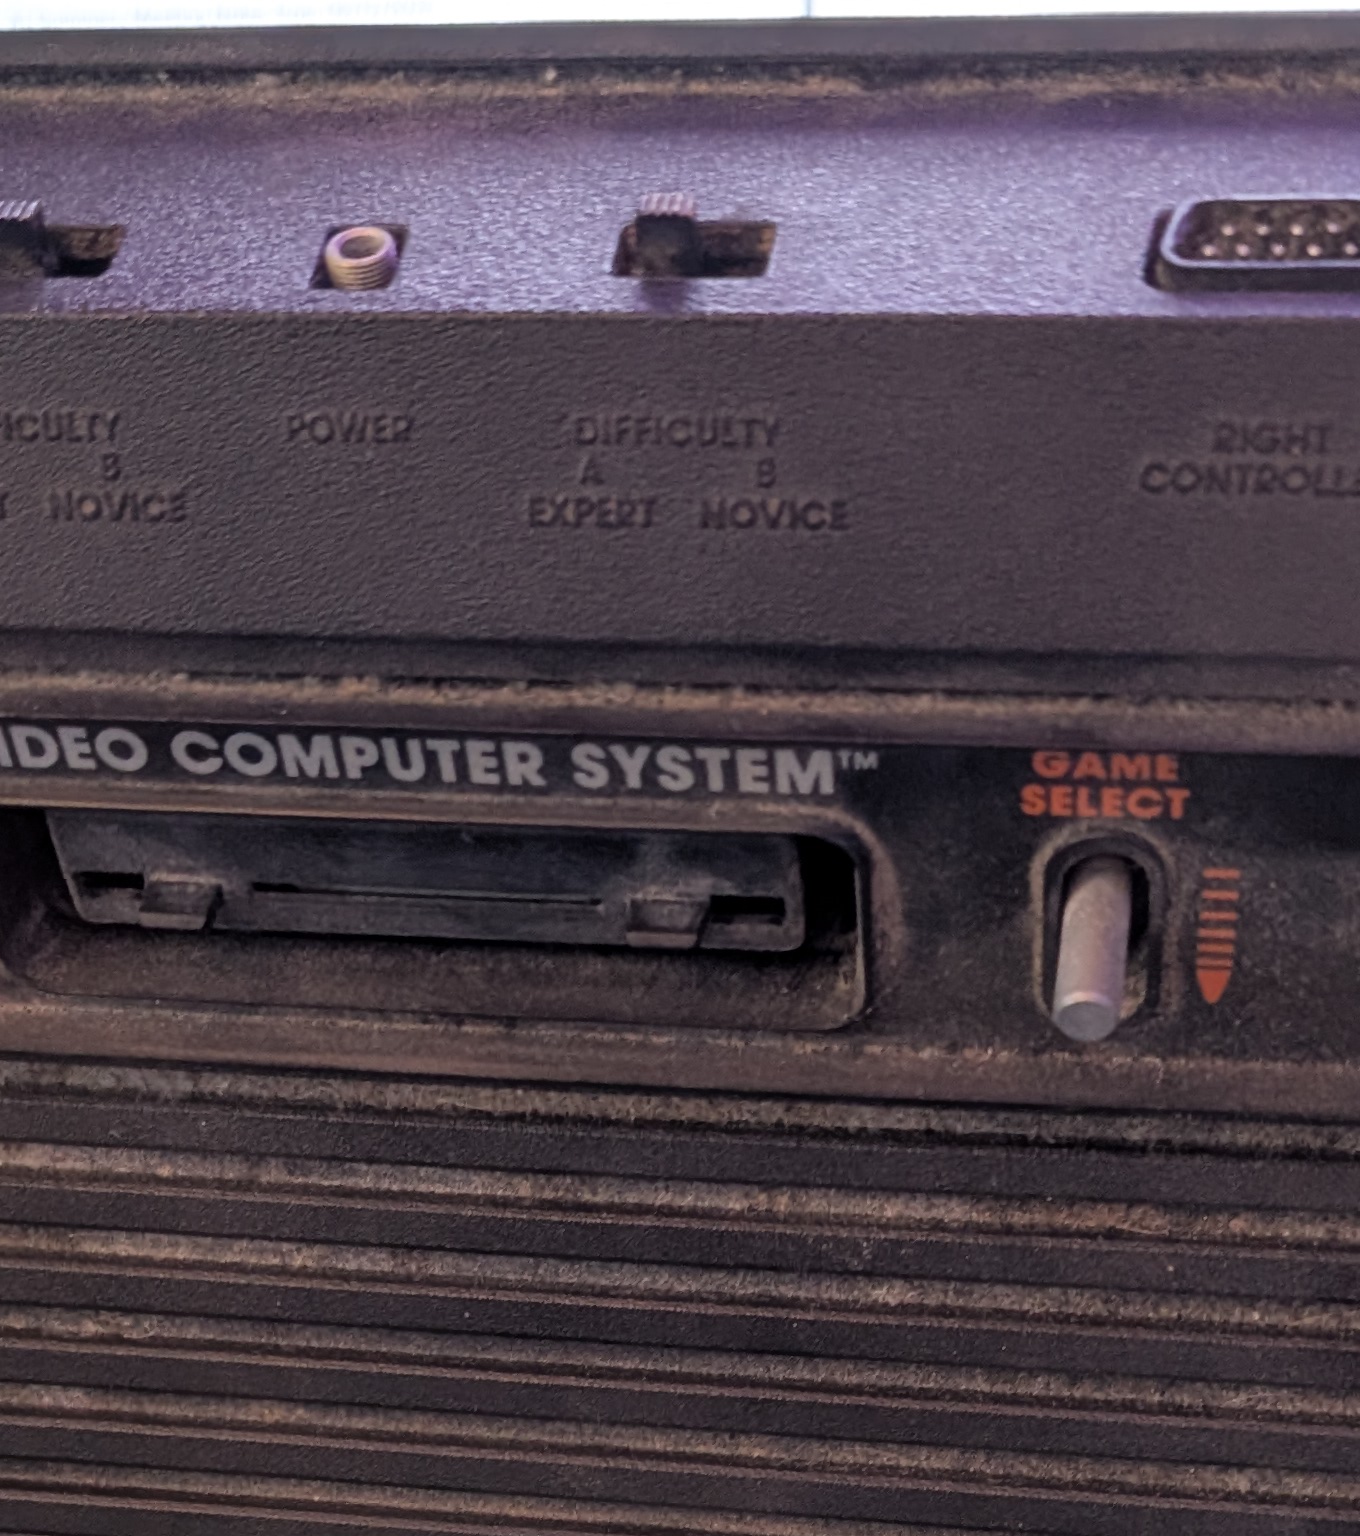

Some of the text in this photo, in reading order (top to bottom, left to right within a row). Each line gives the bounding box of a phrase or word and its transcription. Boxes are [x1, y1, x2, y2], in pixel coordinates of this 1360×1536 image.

[287, 412, 414, 444] POWER
[576, 415, 780, 448] DIFFICULTY
[1214, 421, 1332, 454] RIGHT
[101, 452, 122, 482] B
[755, 456, 777, 488] B
[47, 490, 187, 522] NOVICE
[528, 496, 851, 532] EXPERT NOVICE
[170, 730, 547, 787] COMPUTER
[1030, 750, 1181, 783] GAME
[1020, 785, 1191, 820] SELECT
